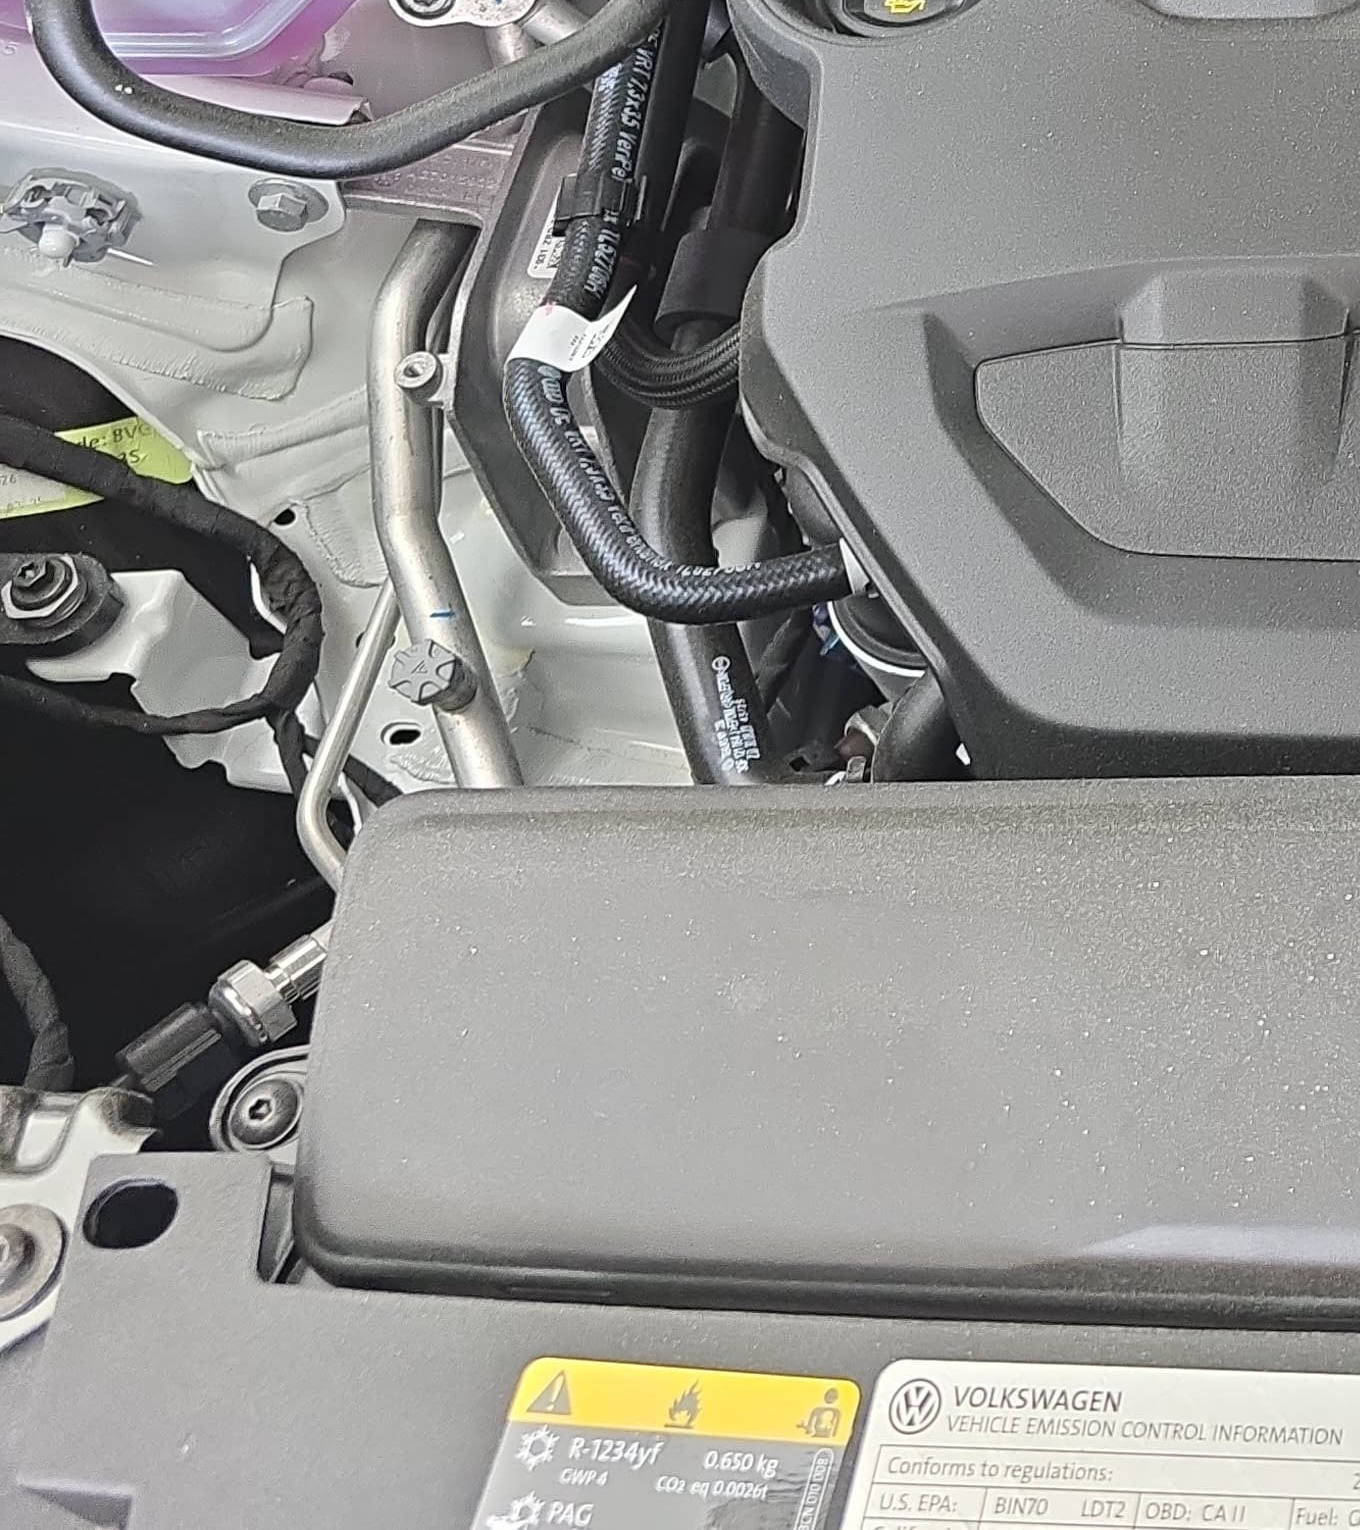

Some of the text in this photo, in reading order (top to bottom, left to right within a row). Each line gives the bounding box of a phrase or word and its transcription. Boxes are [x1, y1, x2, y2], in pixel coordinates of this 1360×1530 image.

[954, 1385, 1122, 1413] VOLKSWAGEN
[947, 1415, 1343, 1446] VEHICLE EMISSION CONTROL INFORMATION
[568, 1437, 664, 1470] R-1234yf
[704, 1451, 779, 1479] 0.650 kg
[888, 1455, 975, 1478] Conforms
[980, 1459, 999, 1478] to
[1003, 1459, 1113, 1484] regulations:
[691, 1481, 709, 1498] eq
[549, 1503, 594, 1527] PAG
[879, 1493, 913, 1513] U.S.
[917, 1494, 957, 1514] EPA:
[994, 1496, 1049, 1516] BIN70
[1081, 1499, 1126, 1519] LDT2
[1145, 1502, 1192, 1521] OBD:
[1295, 1506, 1339, 1527] Fuel:
